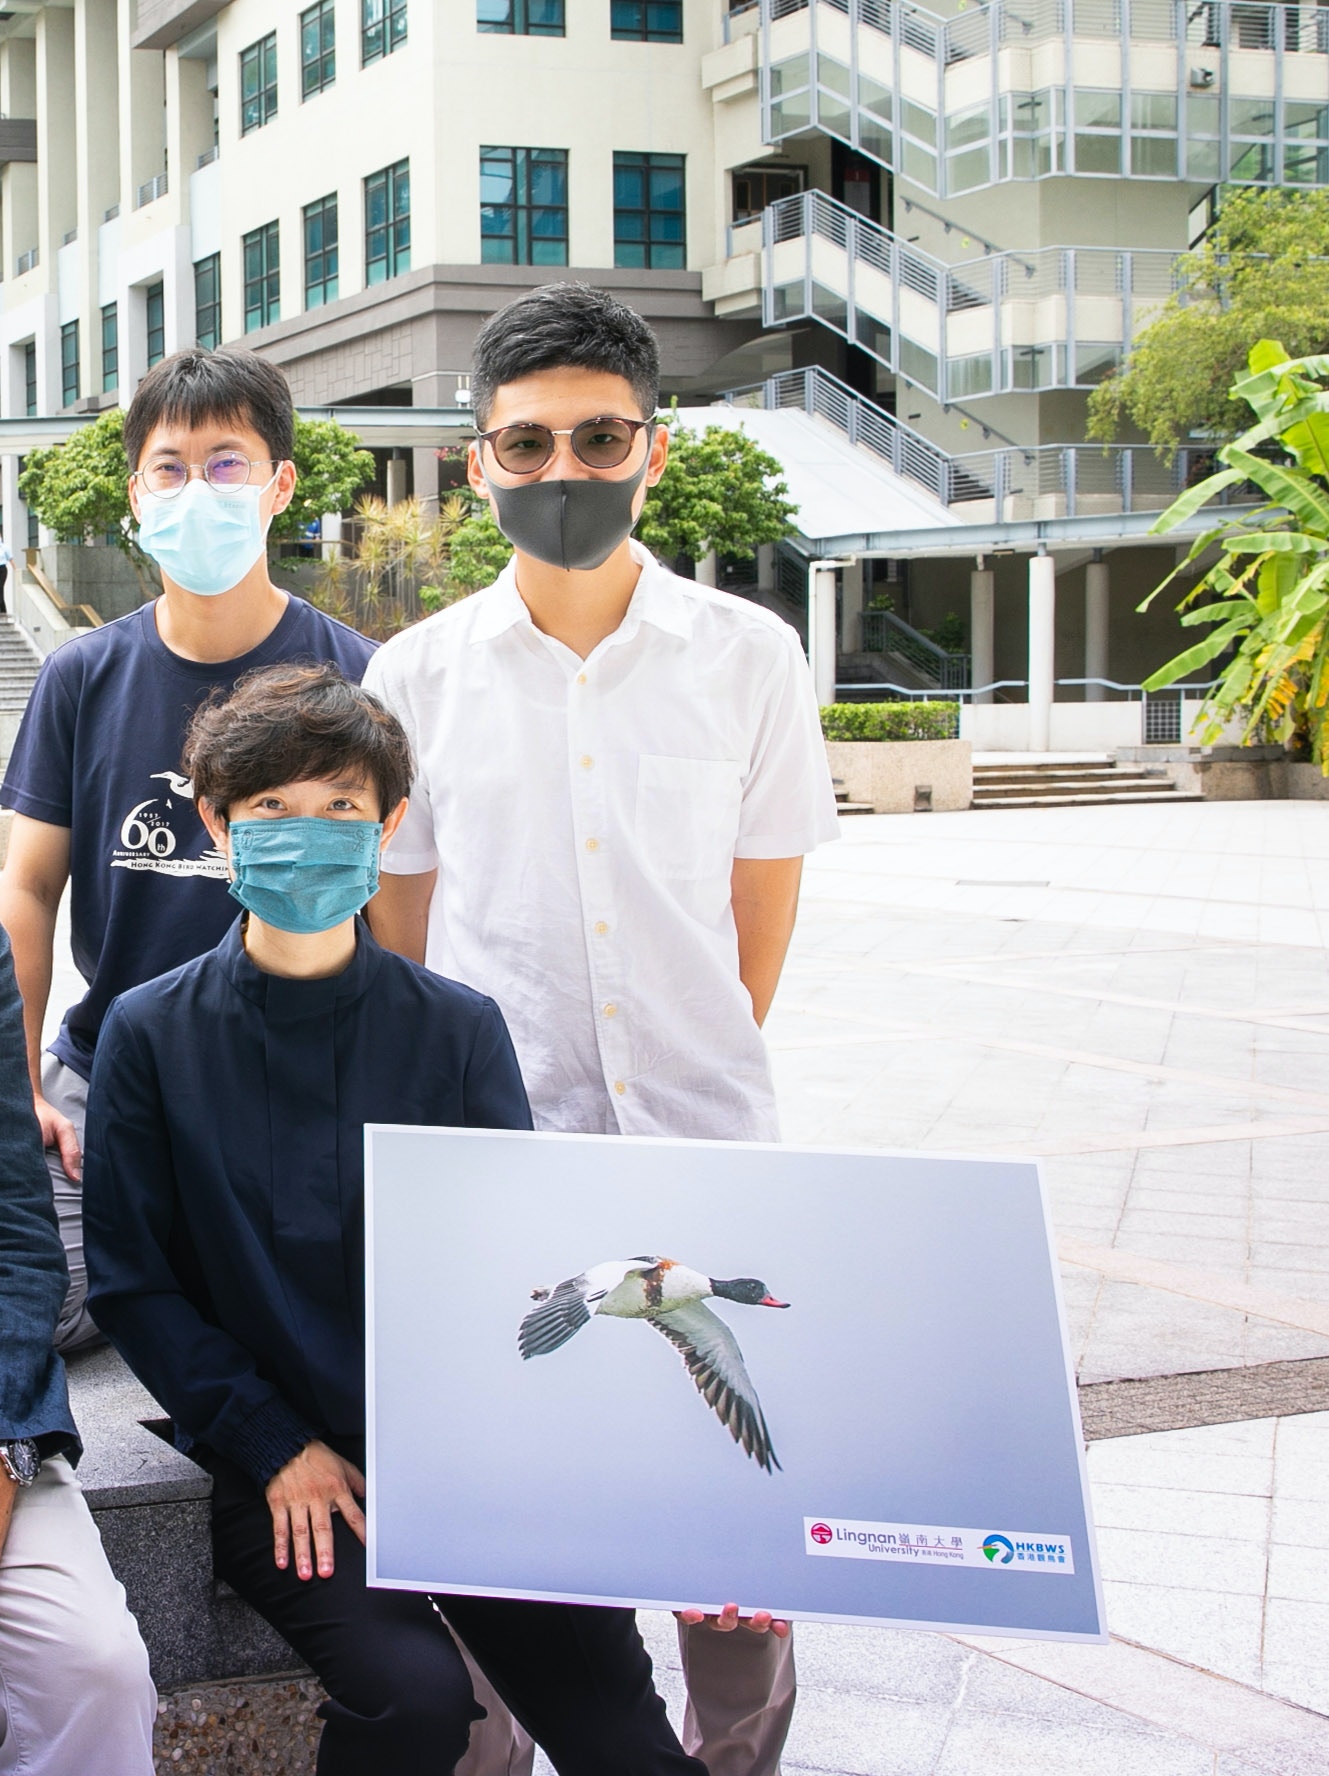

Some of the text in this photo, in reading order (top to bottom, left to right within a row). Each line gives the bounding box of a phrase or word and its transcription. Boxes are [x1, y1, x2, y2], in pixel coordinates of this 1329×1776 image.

[837, 1528, 896, 1545] Lingnan
[868, 1544, 919, 1557] University
[1016, 1542, 1065, 1554] HKBWS
